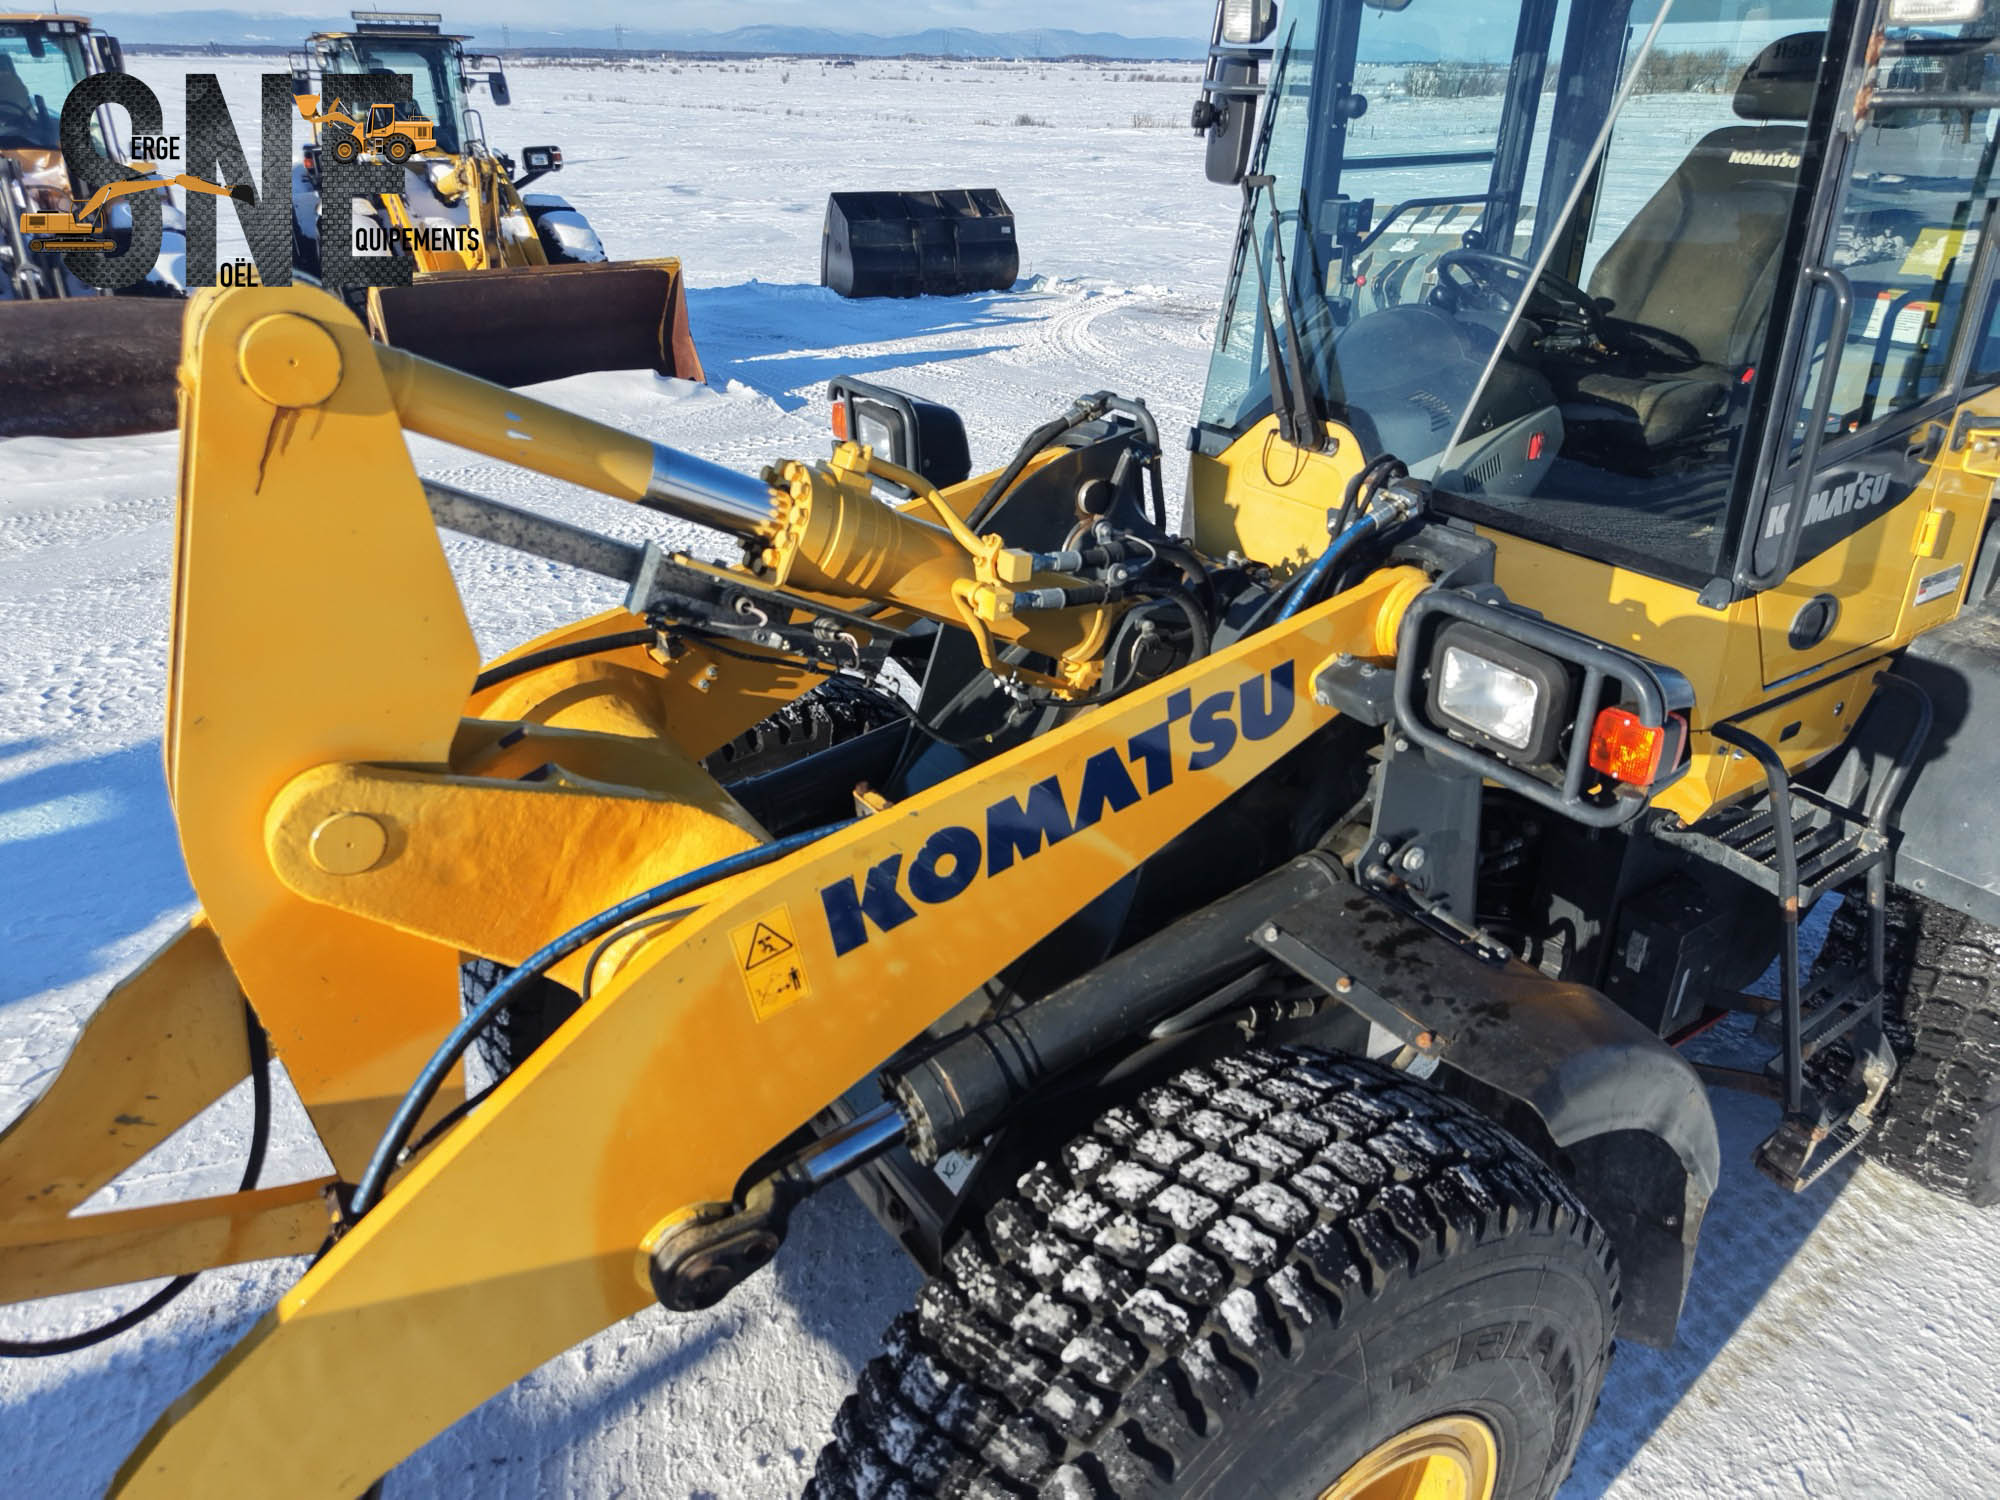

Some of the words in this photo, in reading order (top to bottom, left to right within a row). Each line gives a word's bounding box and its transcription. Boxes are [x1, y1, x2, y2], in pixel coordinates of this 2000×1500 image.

[1728, 151, 1801, 168] KOMATSU
[1764, 471, 1892, 539] KMATSU
[820, 658, 1296, 958] KOMATSU
